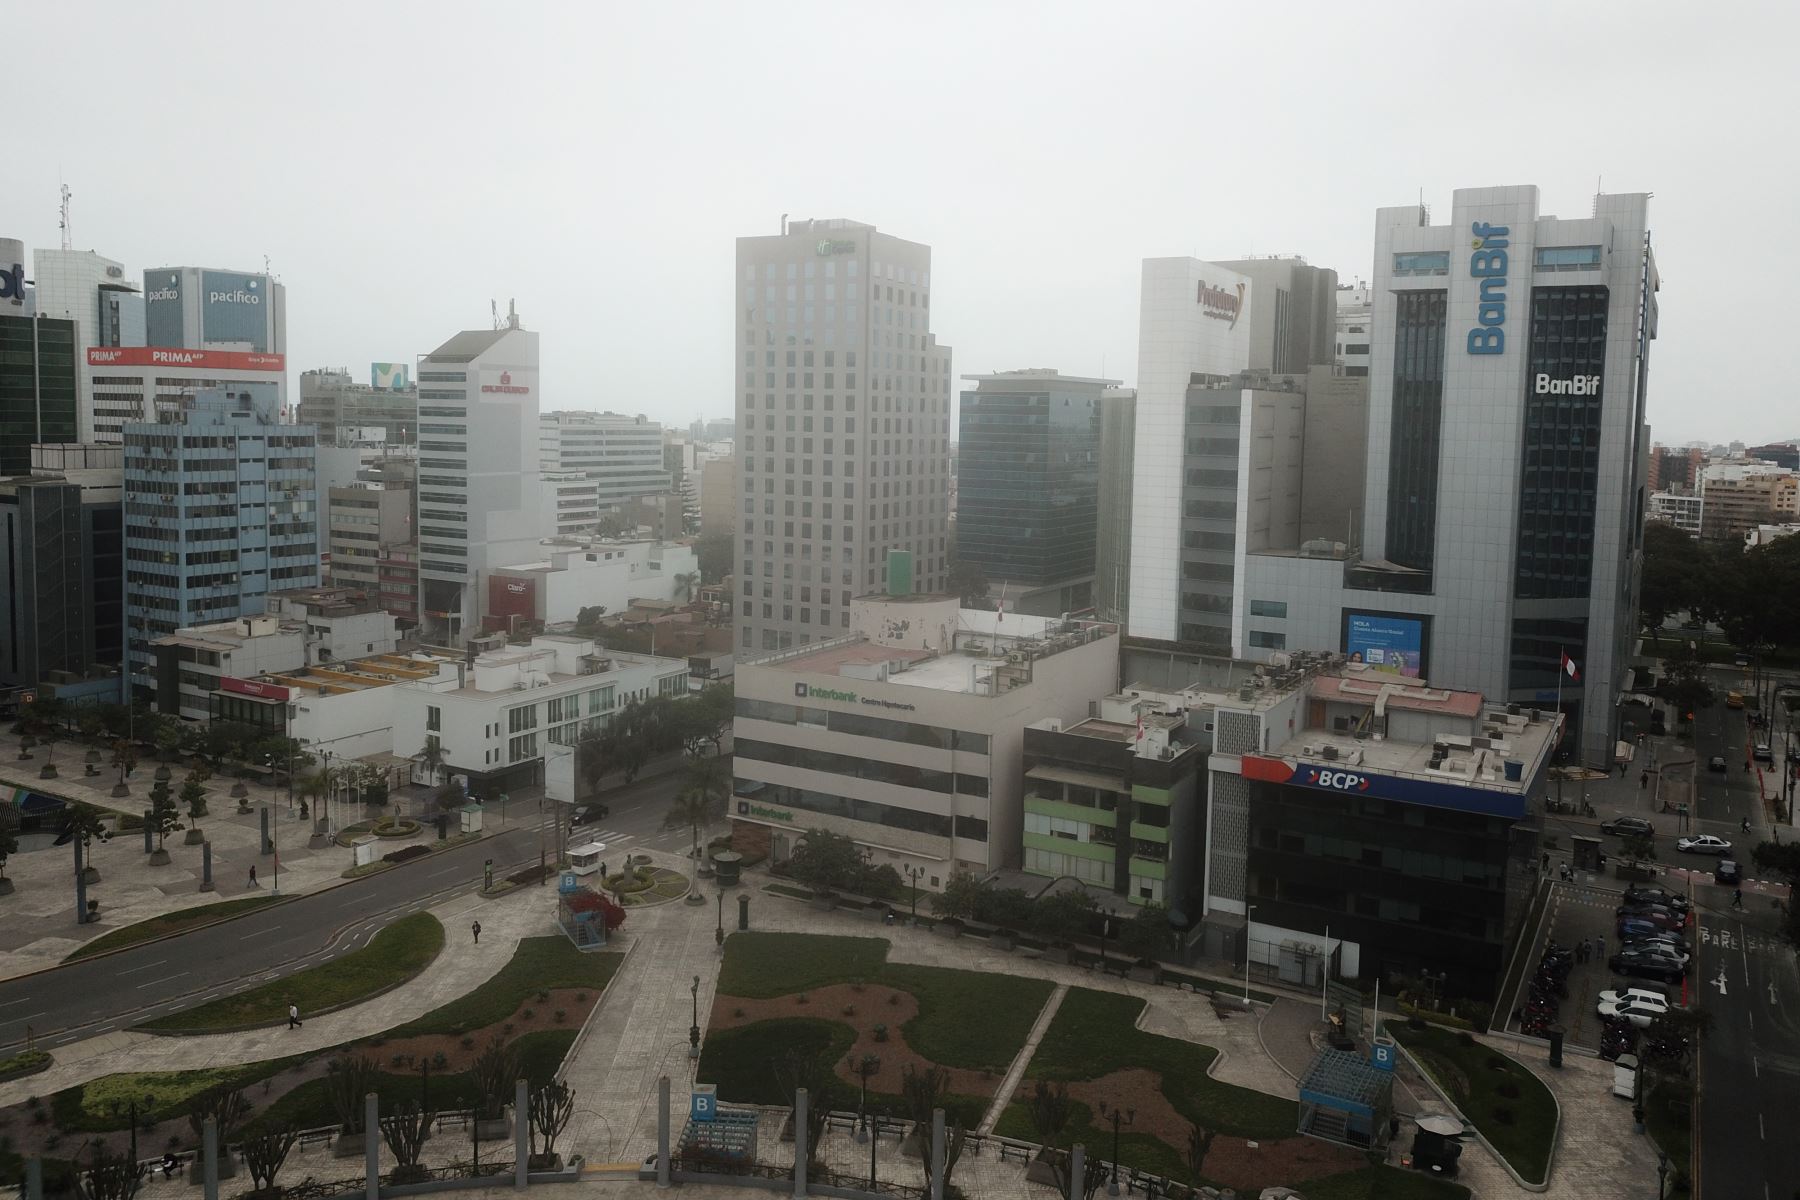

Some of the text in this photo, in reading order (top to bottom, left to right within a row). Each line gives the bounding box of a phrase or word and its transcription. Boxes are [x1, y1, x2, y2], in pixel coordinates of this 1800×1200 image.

[1467, 221, 1510, 355] BanBif
[91, 351, 115, 361] PRIMA
[152, 351, 193, 363] PRIMA
[1535, 373, 1601, 396] BanBif
[809, 686, 857, 702] Interbank
[1318, 770, 1359, 790] BCP
[565, 876, 574, 887] B
[1376, 1047, 1388, 1062] B
[696, 1097, 708, 1111] B
